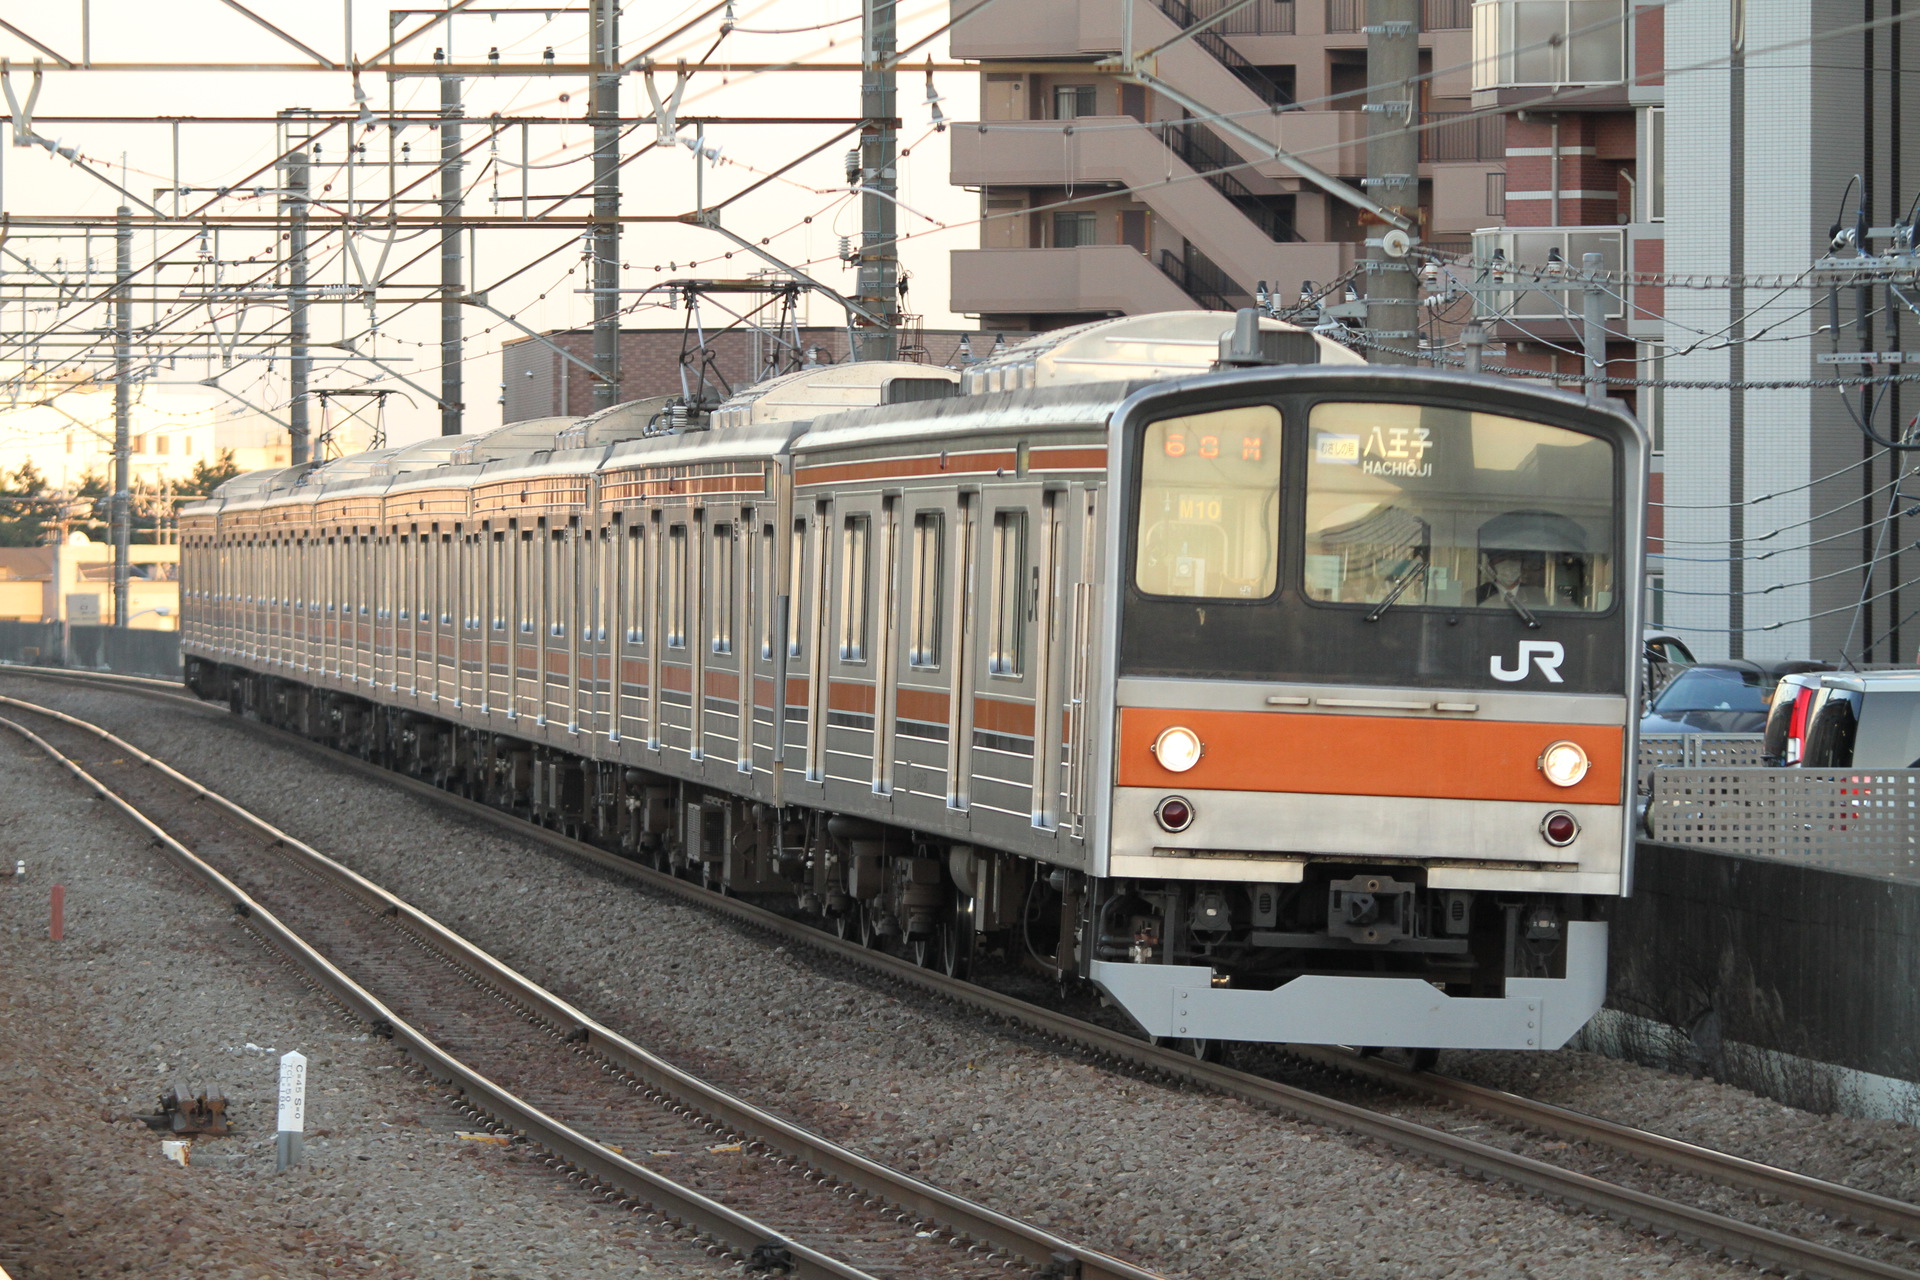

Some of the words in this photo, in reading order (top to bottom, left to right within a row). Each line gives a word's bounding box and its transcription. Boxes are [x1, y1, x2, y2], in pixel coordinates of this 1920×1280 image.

[1320, 442, 1355, 456] むさしの号
[1363, 426, 1433, 459] 八王子
[1180, 501, 1221, 519] M10
[1028, 566, 1039, 622] JR
[1490, 640, 1565, 683] JR
